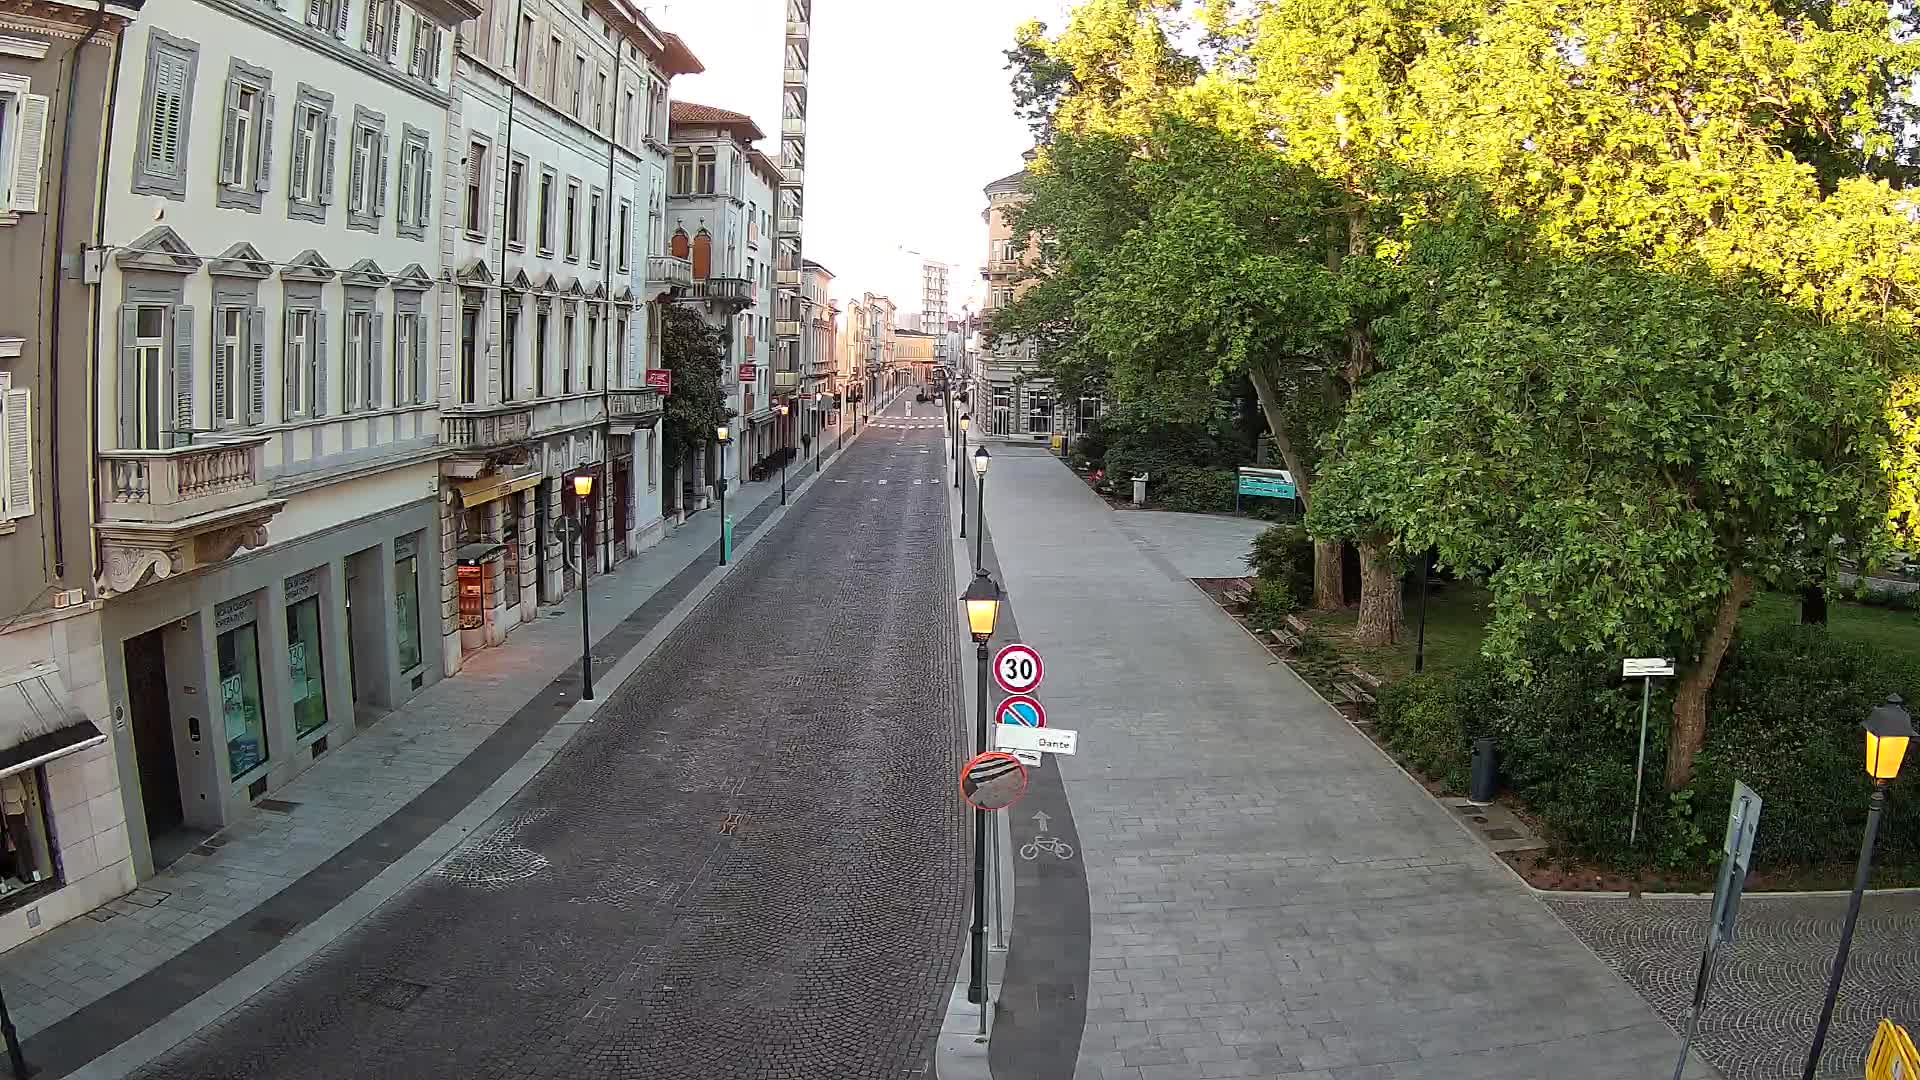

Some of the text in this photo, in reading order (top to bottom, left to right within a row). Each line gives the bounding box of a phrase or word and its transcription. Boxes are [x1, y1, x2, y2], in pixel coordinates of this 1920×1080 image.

[1005, 659, 1033, 680] 30
[223, 677, 241, 700] 130
[1039, 738, 1070, 749] Dante
